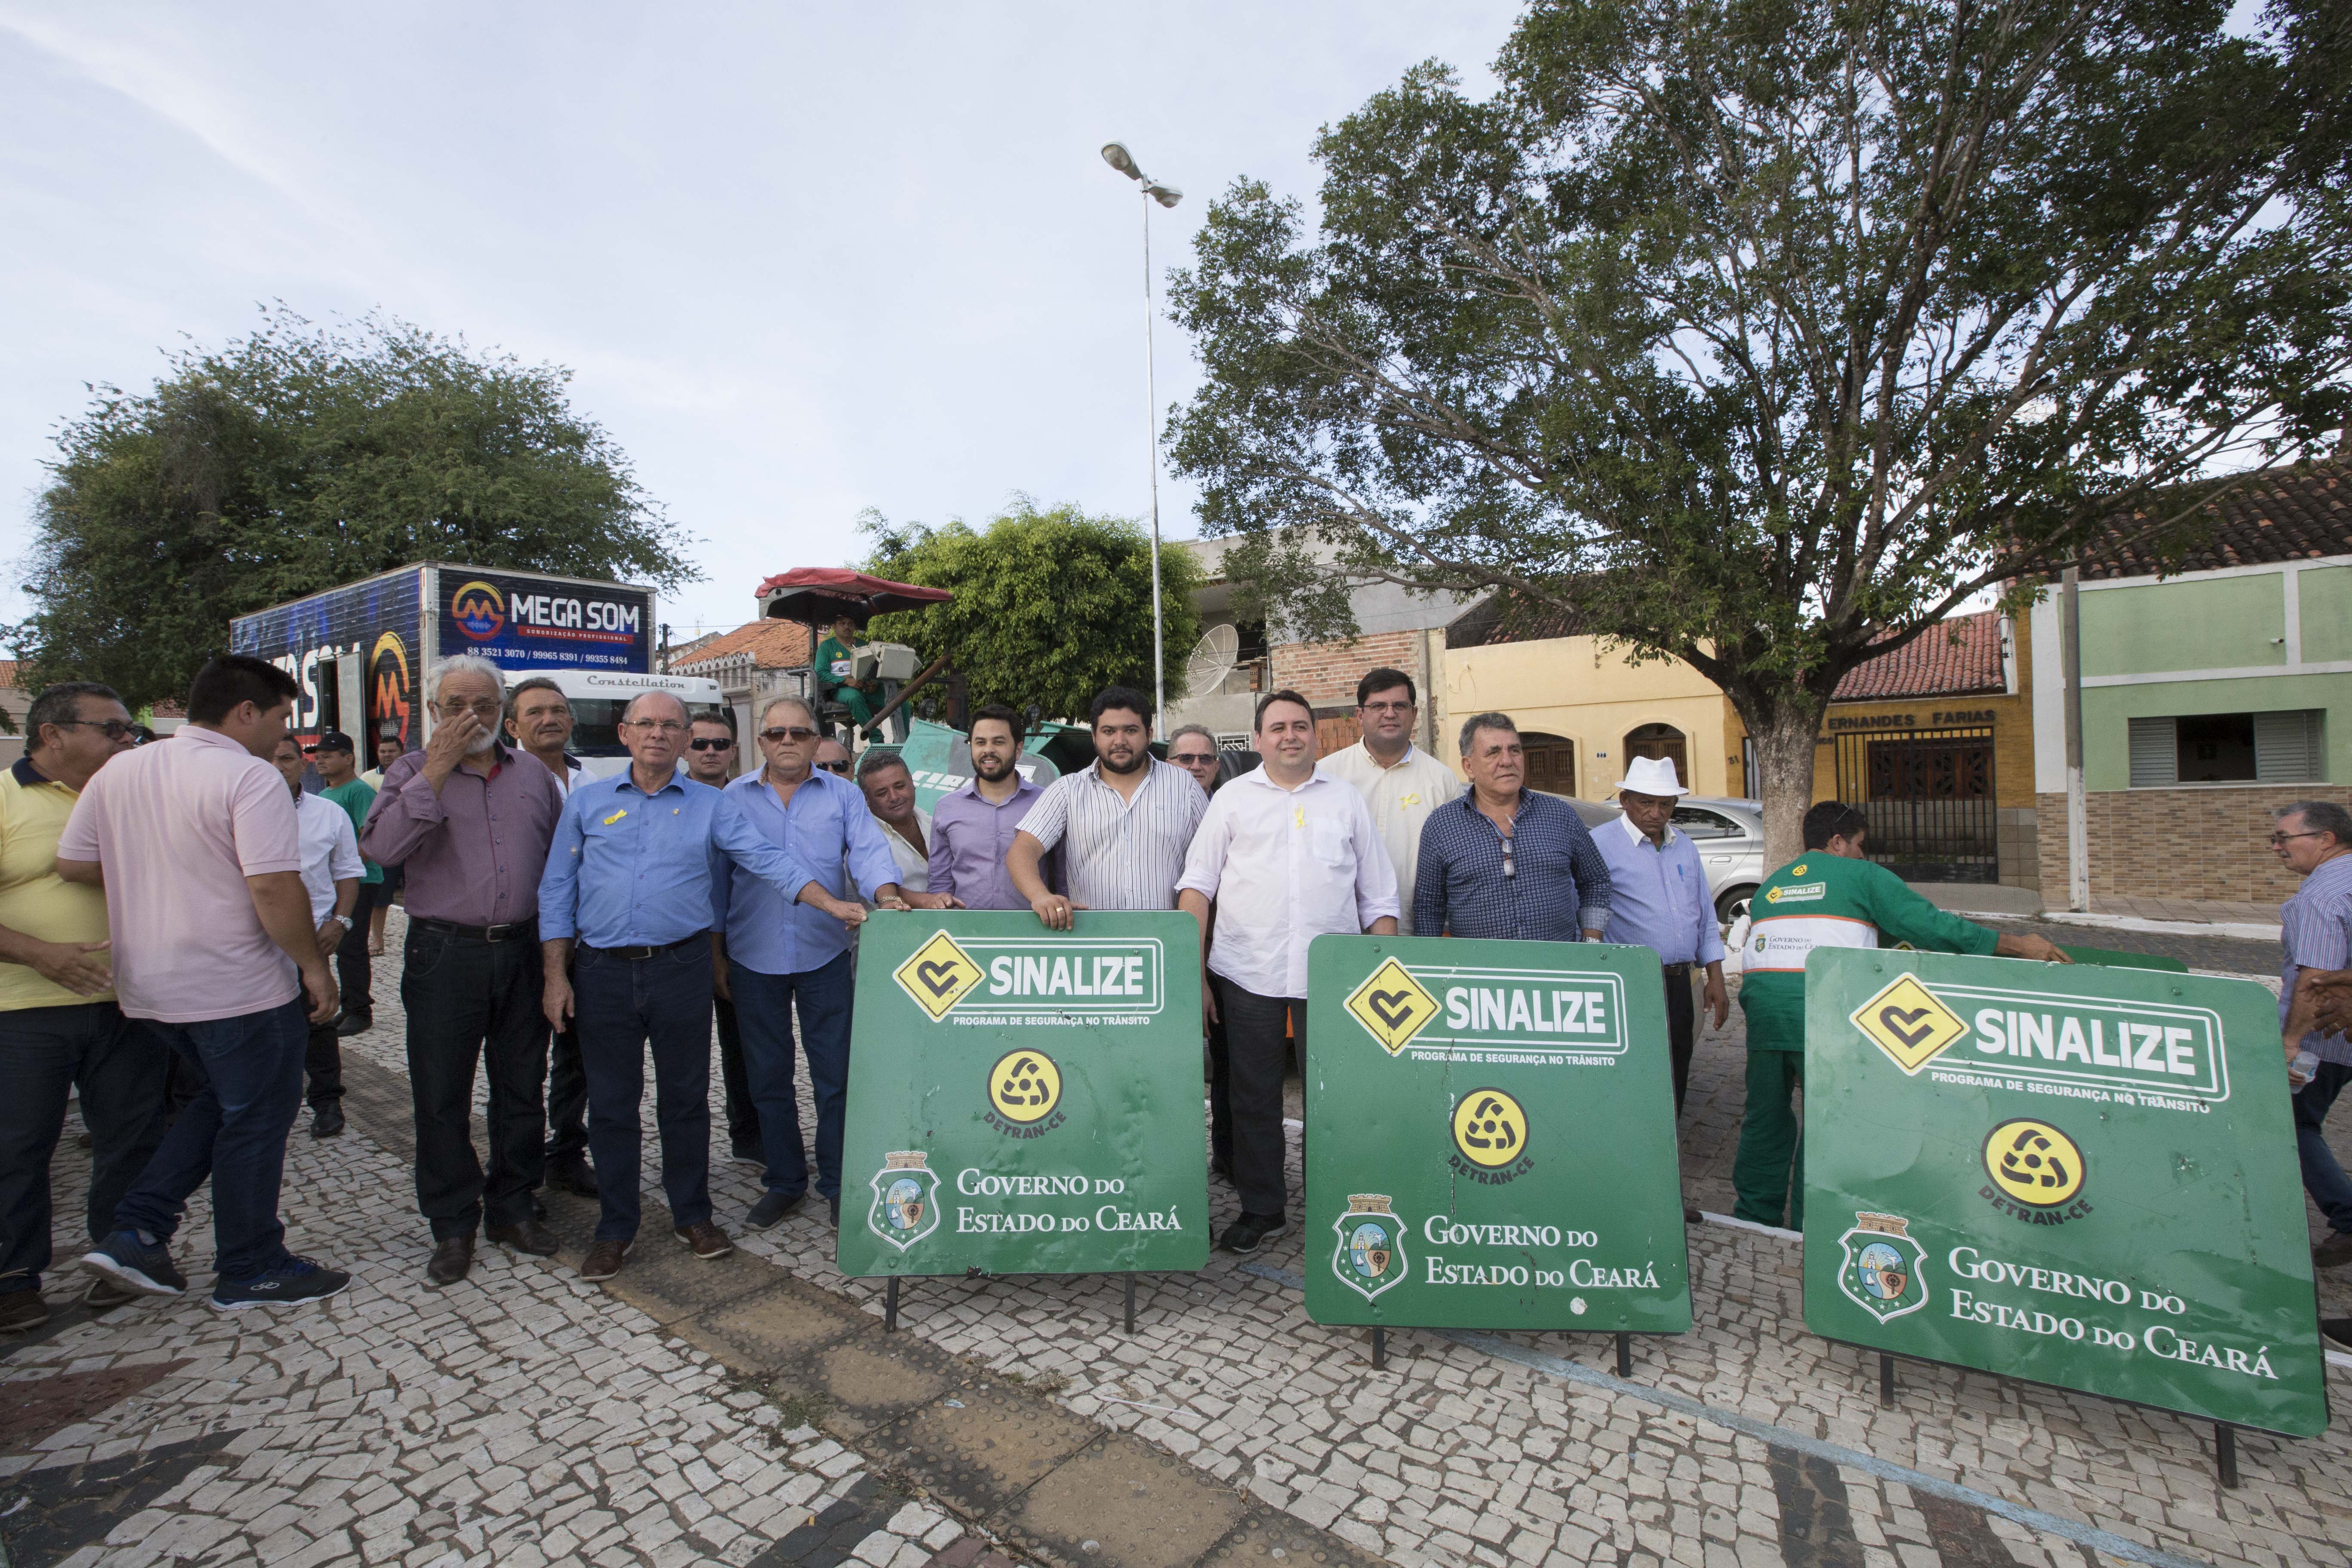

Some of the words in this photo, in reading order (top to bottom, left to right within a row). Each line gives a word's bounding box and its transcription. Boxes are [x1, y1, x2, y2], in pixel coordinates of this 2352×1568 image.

[511, 593, 582, 628] MEGA
[587, 601, 639, 633] SOM
[527, 629, 575, 637] SONORIZAÇÃO
[467, 647, 479, 655] 88
[481, 647, 502, 656] 3521
[505, 649, 525, 658] 3070
[533, 651, 557, 660] 99965
[559, 652, 578, 661] 8391
[585, 654, 608, 663] 99355
[610, 656, 627, 665] 8484
[587, 675, 686, 689] Constellation
[1932, 709, 1995, 724] FARIAS
[1783, 886, 1821, 895] SINALIZE
[989, 956, 1143, 995] SINALIZE
[953, 1017, 1007, 1025] PROGRAMA
[1010, 1017, 1023, 1025] DE
[1025, 1017, 1084, 1027] SEGURANÇA
[1086, 1017, 1100, 1025] NO
[1102, 1015, 1150, 1025] TRÂNSITO
[1446, 986, 1606, 1033] SINALIZE
[1975, 1008, 2196, 1076] SINALIZE
[1412, 1051, 1467, 1062] PROGRAMA
[1470, 1053, 1483, 1063] DE
[1485, 1054, 1547, 1066] SEGURANÇA
[1549, 1056, 1563, 1065] NO
[1566, 1055, 1615, 1066] TRÂNSITO
[1931, 1072, 2003, 1088] PROGRAMA
[2006, 1080, 2024, 1091] DE
[2027, 1082, 2110, 1102] SEGURANÇA
[2114, 1092, 2135, 1106] NO
[2139, 1095, 2210, 1114] TRÂNSITO
[983, 1111, 1067, 1139] DETRAN-CE
[957, 1168, 1088, 1195] GOVERNO
[1448, 1154, 1535, 1185] DETRAN-CE
[956, 1207, 1055, 1233] ESTADO
[1978, 1185, 2094, 1225] DETRAN-CE
[1424, 1215, 1561, 1246] GOVERNO
[1425, 1256, 1528, 1286] ESTADO
[1949, 1246, 2131, 1304] GOVERNO
[1950, 1288, 2085, 1340] ESTADO
